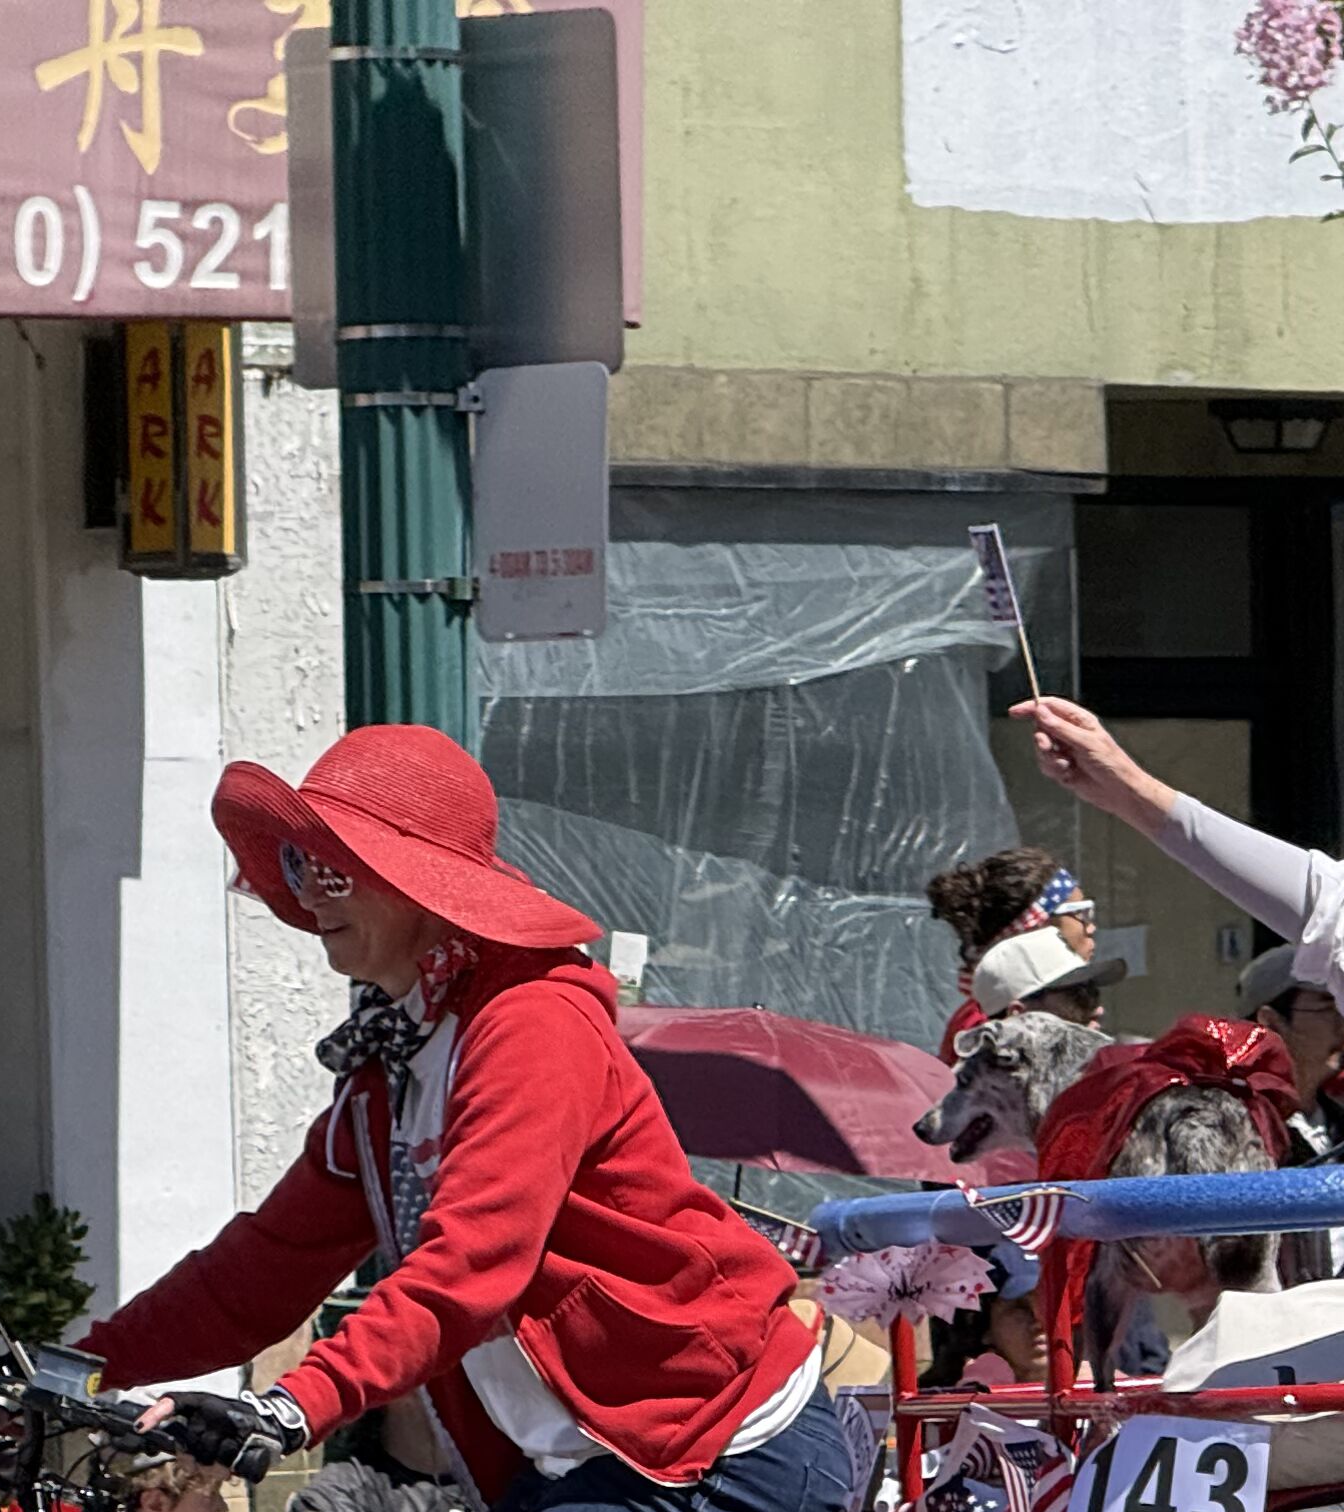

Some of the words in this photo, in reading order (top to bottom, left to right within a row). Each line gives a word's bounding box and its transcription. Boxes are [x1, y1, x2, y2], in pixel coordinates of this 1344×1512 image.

[133, 201, 289, 290] 521
[136, 346, 169, 527] ARK
[192, 347, 224, 528] ARK
